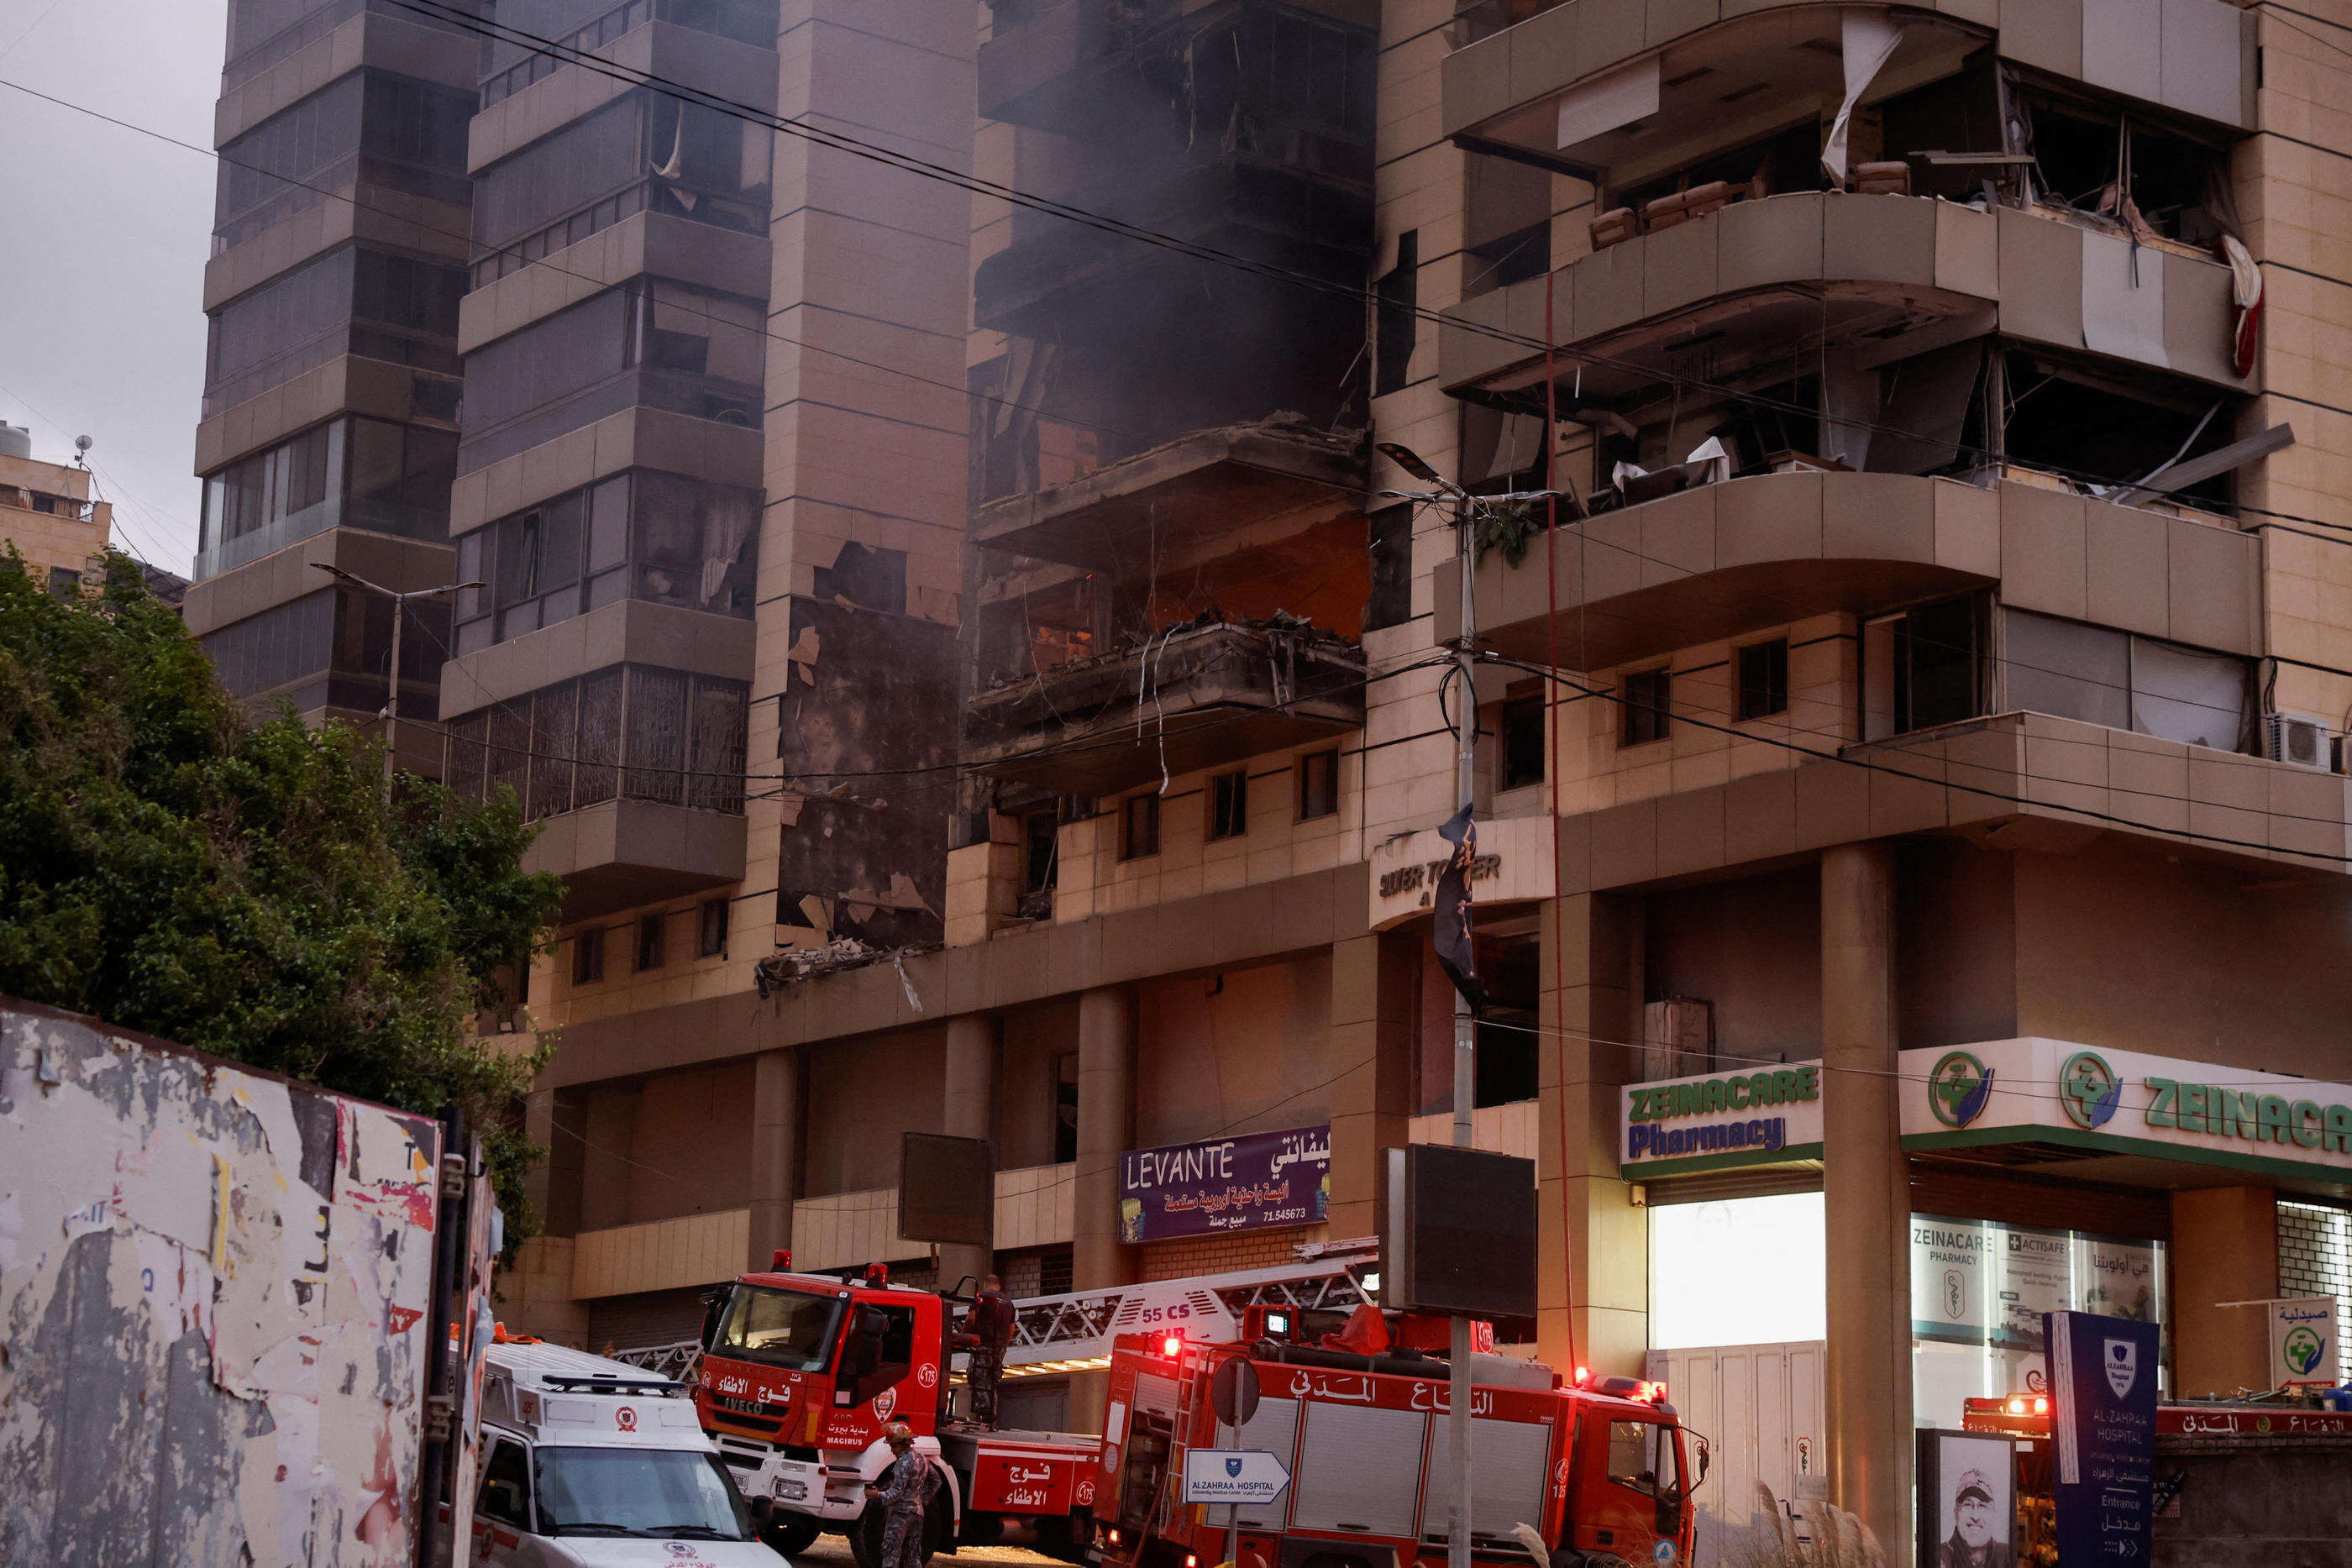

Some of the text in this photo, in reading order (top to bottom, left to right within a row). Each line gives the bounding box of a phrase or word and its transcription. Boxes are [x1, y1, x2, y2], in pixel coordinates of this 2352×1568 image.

[1379, 864, 1425, 898] SILVER
[1629, 1066, 1819, 1122] ZEINACARE
[1629, 1117, 1785, 1159] Pharmacy
[1270, 1131, 1331, 1180] ليفانتي
[1127, 1141, 1236, 1190] LEVANTE
[1263, 1208, 1305, 1222] 71.545673
[1914, 1229, 1992, 1252] ZEINACARE
[2022, 1238, 2065, 1254] ACTISAFE
[1929, 1251, 1977, 1266] PHARMACY
[1142, 1303, 1190, 1323] 55 CS
[2279, 1307, 2328, 1324] صيدلية
[924, 1370, 936, 1382] 175
[757, 1384, 790, 1403] فوج
[725, 1398, 764, 1416] IVECO
[2094, 1409, 2147, 1425] AL-ZAHRAA
[828, 1424, 848, 1434] بيروت
[2097, 1429, 2142, 1445] HOSPITAL
[827, 1437, 863, 1445] MAGIRUS
[1010, 1462, 1050, 1483] فوج
[1237, 1481, 1274, 1490] HOSPITAL
[2102, 1495, 2140, 1511] Entrance
[2102, 1513, 2140, 1532] مدخل
